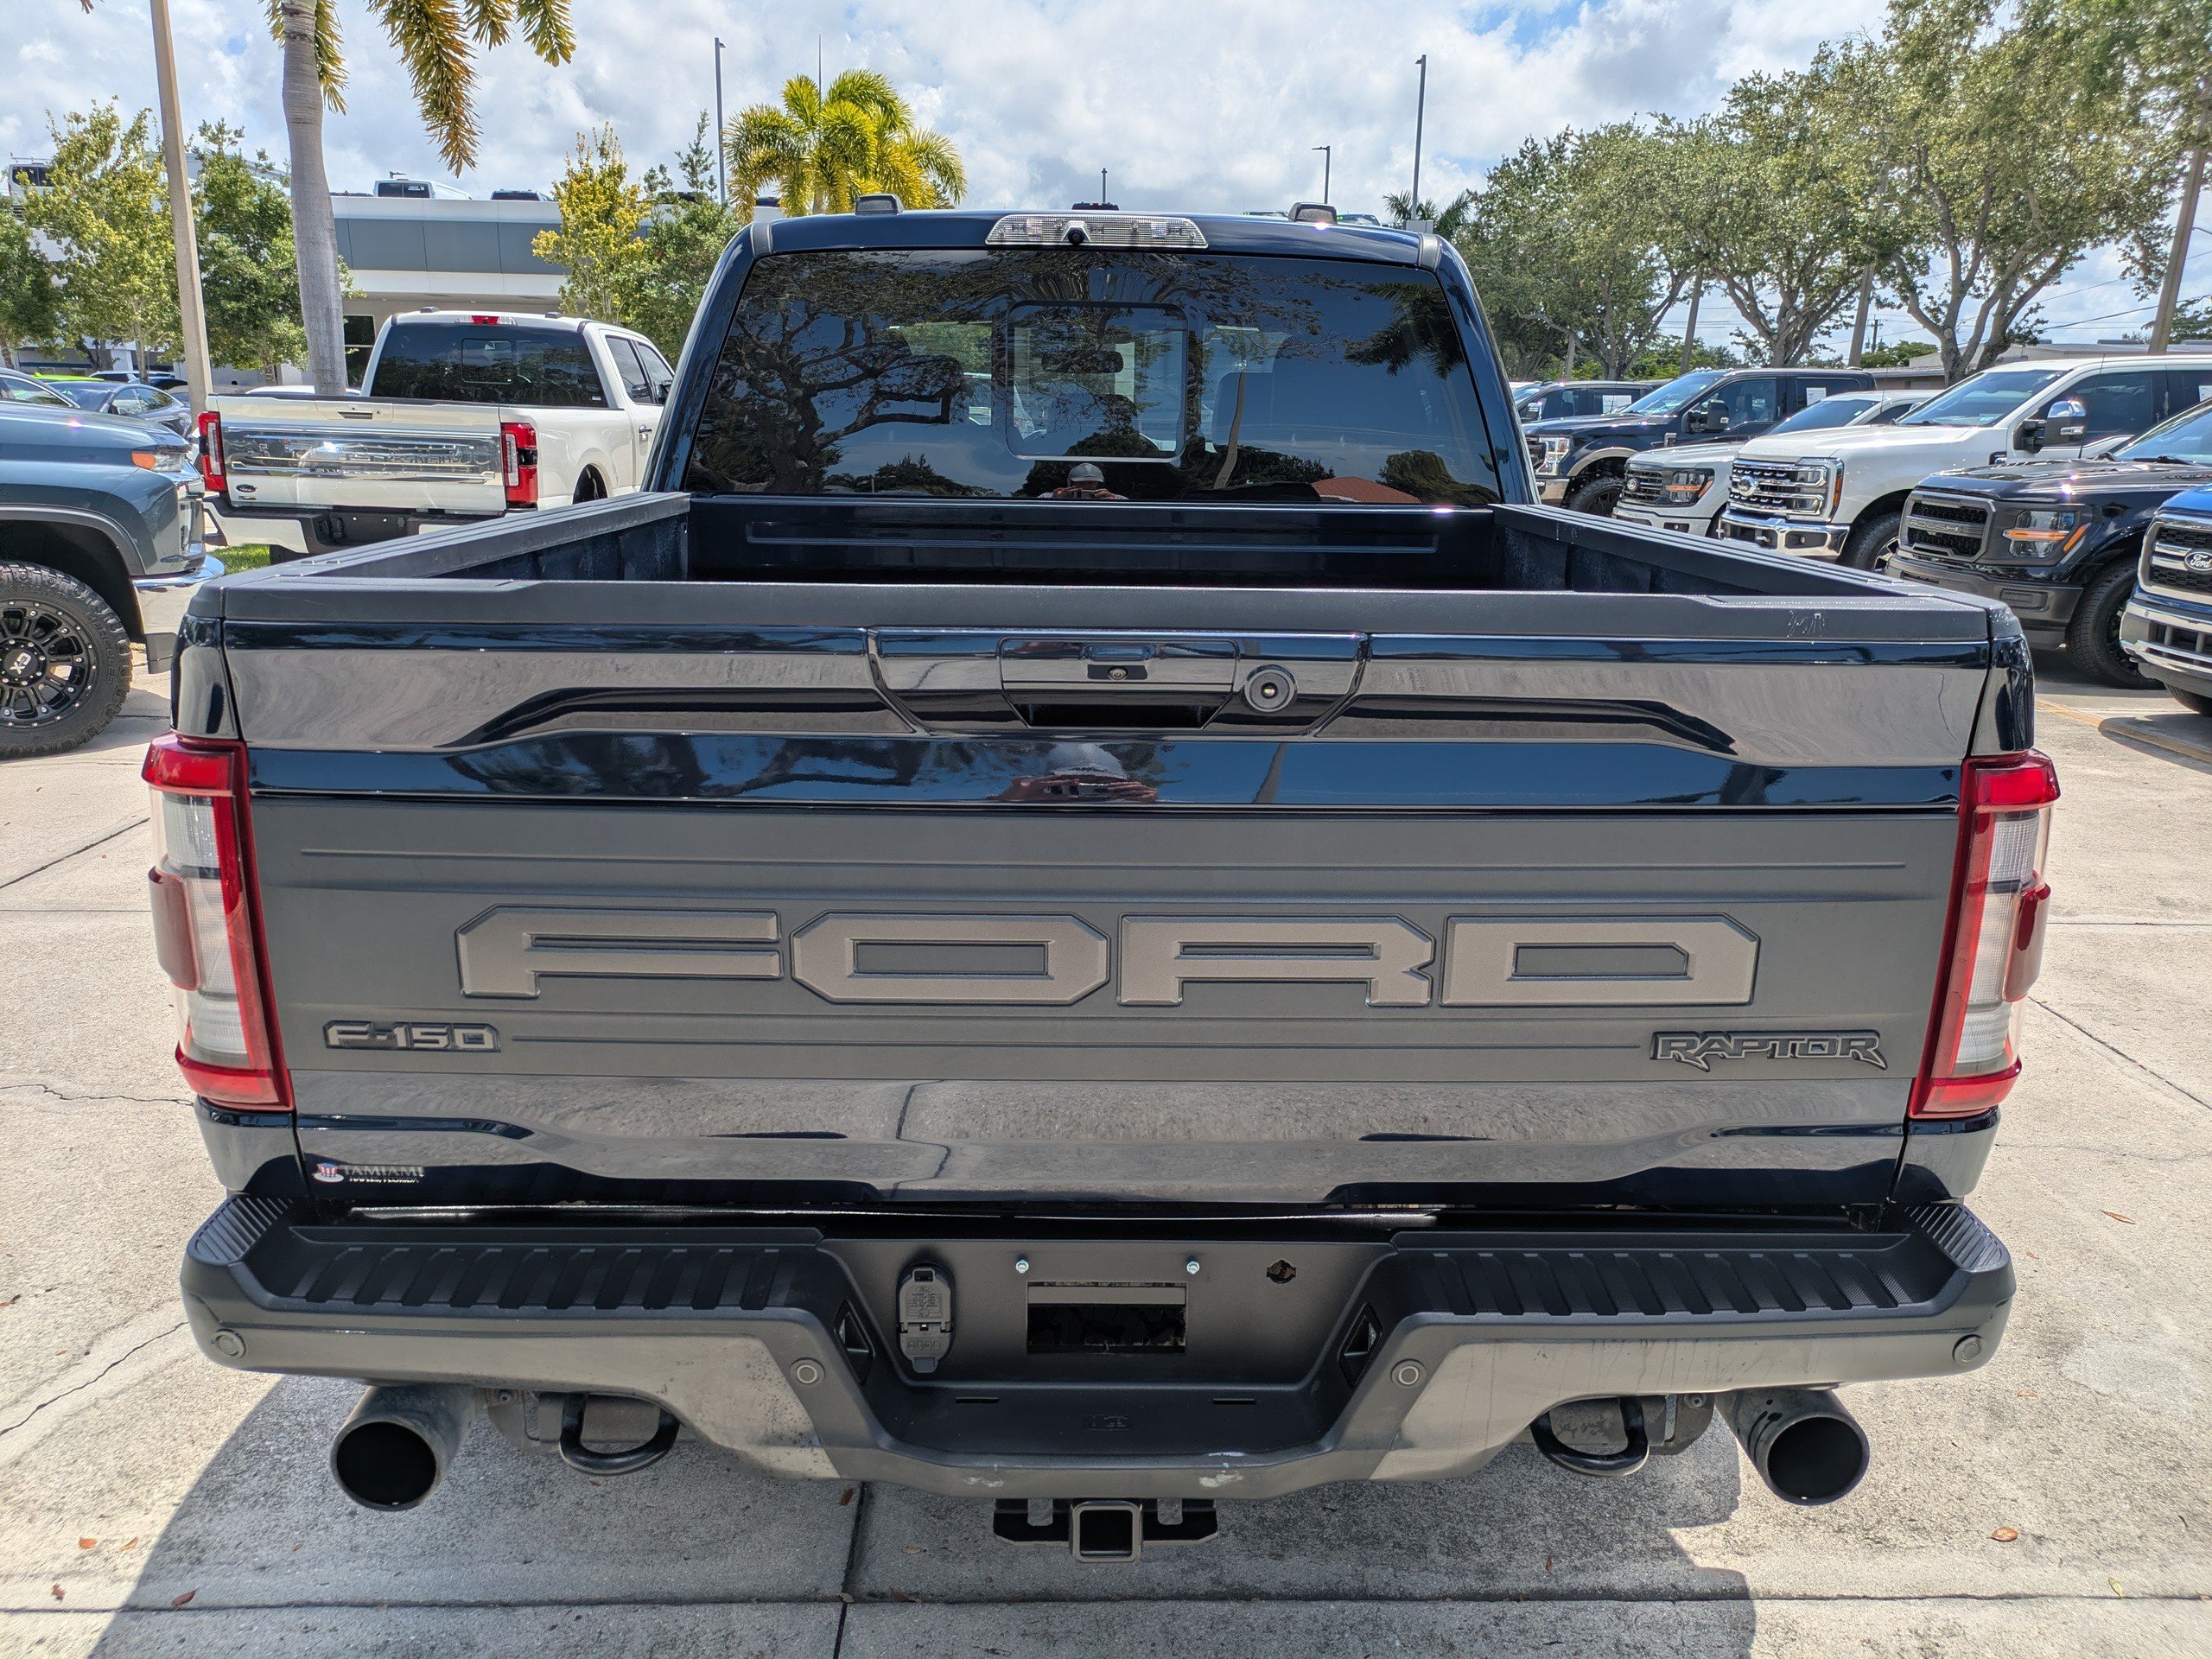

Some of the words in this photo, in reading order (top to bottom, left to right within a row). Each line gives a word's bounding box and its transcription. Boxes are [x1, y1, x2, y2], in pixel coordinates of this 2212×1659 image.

[1909, 519, 1959, 532] ROUSH
[2190, 553, 2212, 568] Ford
[10, 652, 31, 674] XD
[454, 904, 1761, 1007] FORD
[322, 1020, 502, 1052] F-150
[1650, 1030, 1887, 1073] RAPTOR
[343, 1165, 424, 1178] TAMIAMI
